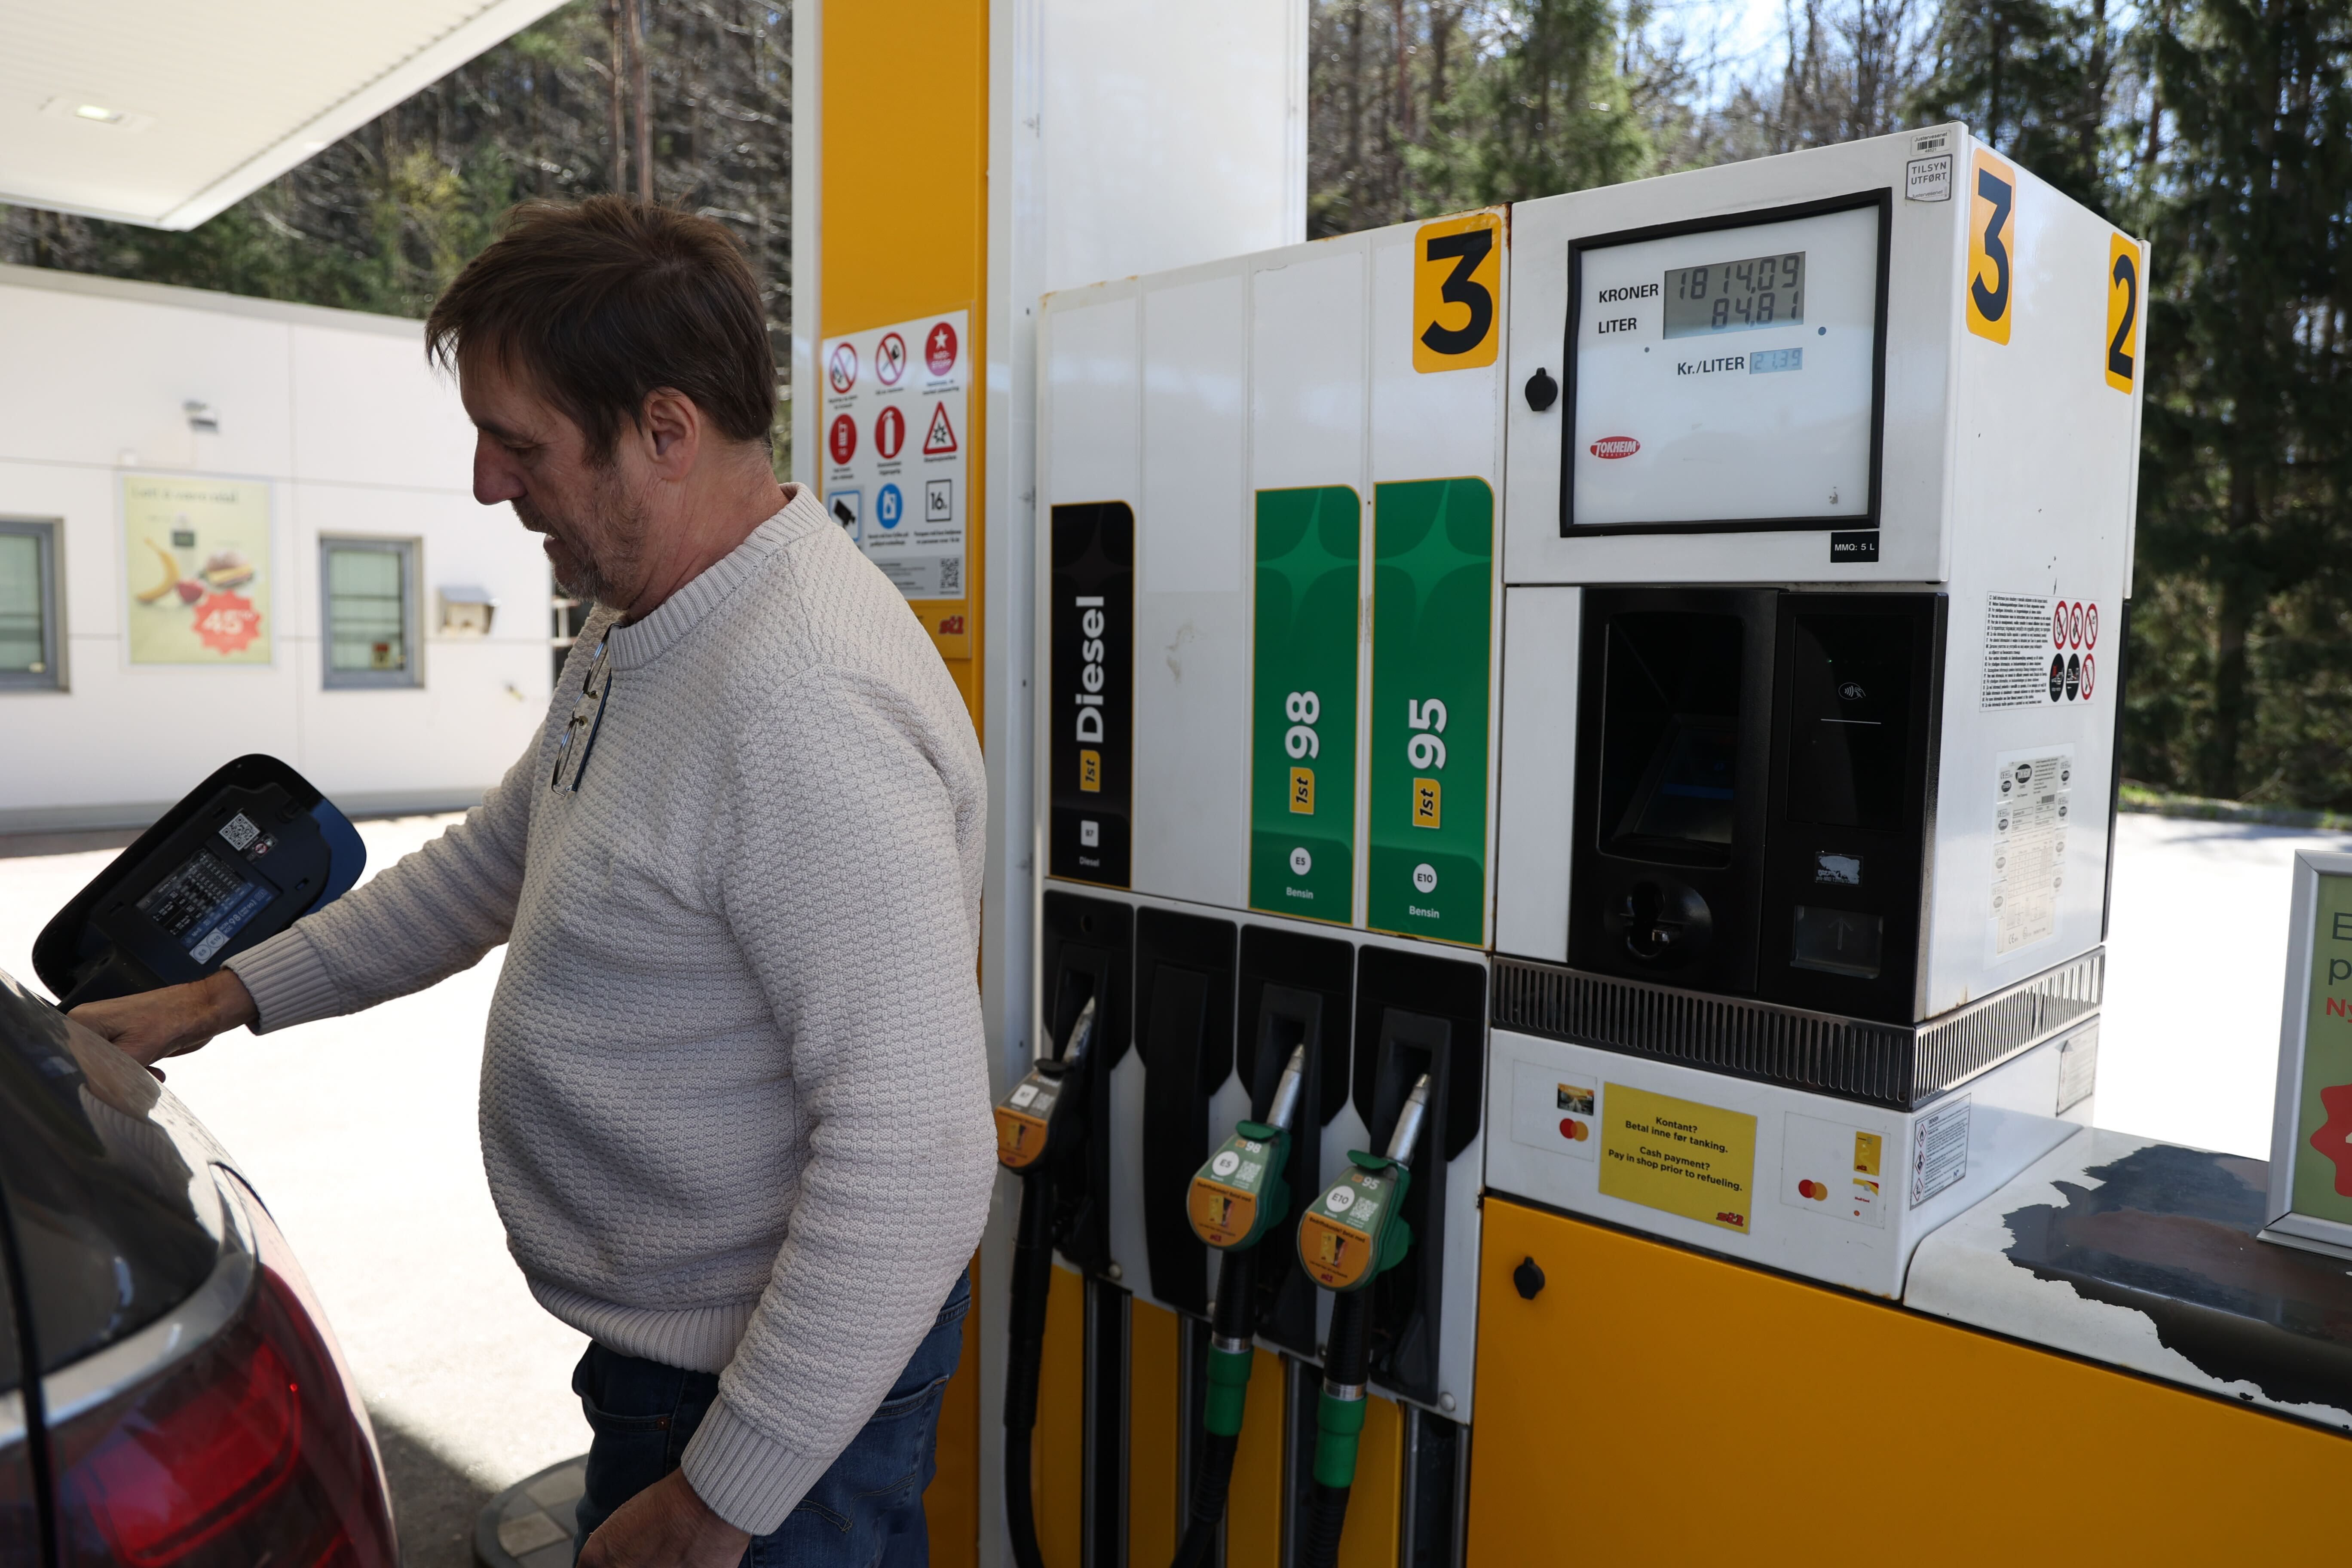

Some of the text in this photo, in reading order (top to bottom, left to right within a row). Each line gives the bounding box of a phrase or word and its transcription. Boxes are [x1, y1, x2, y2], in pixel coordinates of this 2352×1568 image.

[1915, 132, 1948, 142] Justervesenet
[1911, 161, 1947, 174] TILSYN
[1911, 172, 1947, 185] UTFØRT
[1971, 168, 2012, 323] 3
[1421, 228, 1493, 355] 3
[1599, 283, 1659, 303] KRONER
[1711, 291, 1799, 330] 84,81
[2108, 254, 2137, 380] 2
[1598, 317, 1637, 334] LITER
[1677, 356, 1745, 376] Kr./LITER
[1591, 441, 1637, 457] TOKHEIM
[930, 491, 943, 510] 16
[1834, 543, 1858, 551] MMQ:
[1075, 596, 1105, 743] Diesel
[1284, 690, 1320, 760] 98
[1407, 698, 1448, 770] 95
[1085, 758, 1095, 783] 1st
[1295, 776, 1308, 804] 1st
[1419, 787, 1434, 817] 1st
[1079, 856, 1099, 867] Diesel
[1295, 856, 1306, 866] E5
[1417, 873, 1433, 884] E10
[1286, 886, 1314, 900] Bensin
[227, 912, 242, 926] 98
[1409, 905, 1440, 919] Bensin
[209, 934, 221, 946] E10
[1656, 1116, 1698, 1133] Kontant?
[1625, 1120, 1728, 1154] Betal inne før tanking.
[1245, 1141, 1262, 1153] 98
[1219, 1159, 1232, 1168] E5
[1640, 1146, 1711, 1171] Cash payment?
[1608, 1148, 1743, 1192] Pay in shop prior to refueling.
[1362, 1176, 1380, 1190] 95
[1332, 1192, 1349, 1205] E10
[1343, 1230, 1356, 1239] Betal
